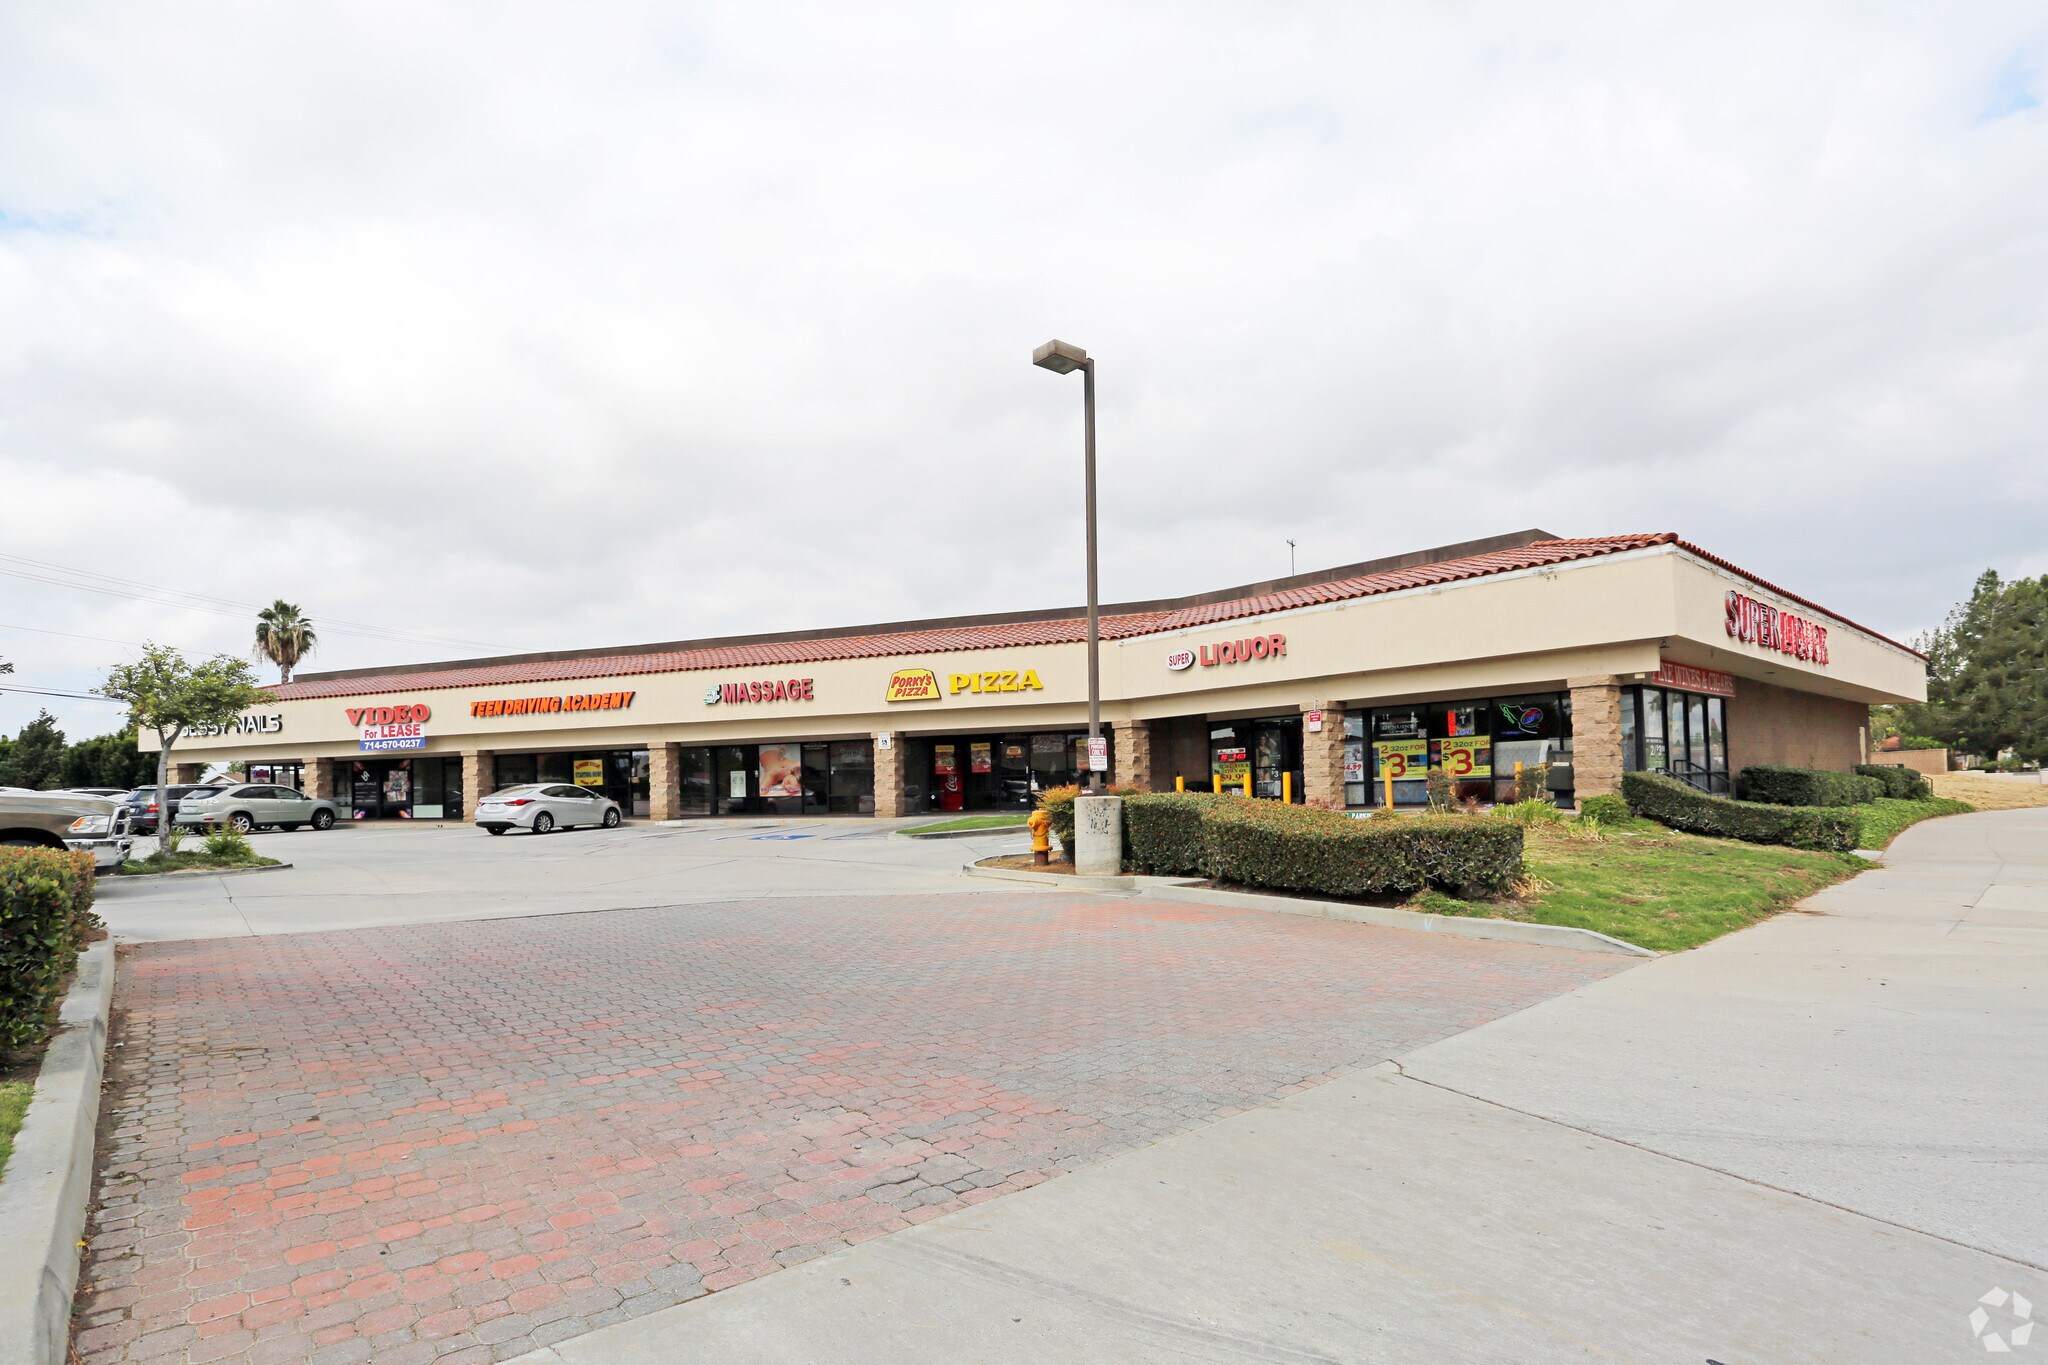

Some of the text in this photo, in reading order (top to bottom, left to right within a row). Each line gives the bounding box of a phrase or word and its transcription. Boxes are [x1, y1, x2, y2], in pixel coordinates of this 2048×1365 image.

[1725, 590, 1829, 665] SUPER LIQUOR
[1168, 652, 1190, 667] SUPER
[1199, 633, 1287, 667] LIQUOR
[891, 673, 932, 689] PORKY'S
[949, 669, 1044, 694] PIZZA
[1674, 666, 1701, 688] WINES
[1702, 671, 1708, 689] &
[1708, 673, 1734, 693] CIGARS
[722, 678, 813, 703] MASSAGE
[894, 686, 929, 698] PIZZA
[470, 691, 635, 717] TEEN DRIVING ACADEMY
[234, 713, 282, 734] NAILS
[345, 703, 431, 727] VIDEO
[364, 723, 421, 739] For LEASE
[363, 739, 421, 750] 714-670-0237
[1381, 745, 1389, 754] 2
[1442, 741, 1452, 751] 2
